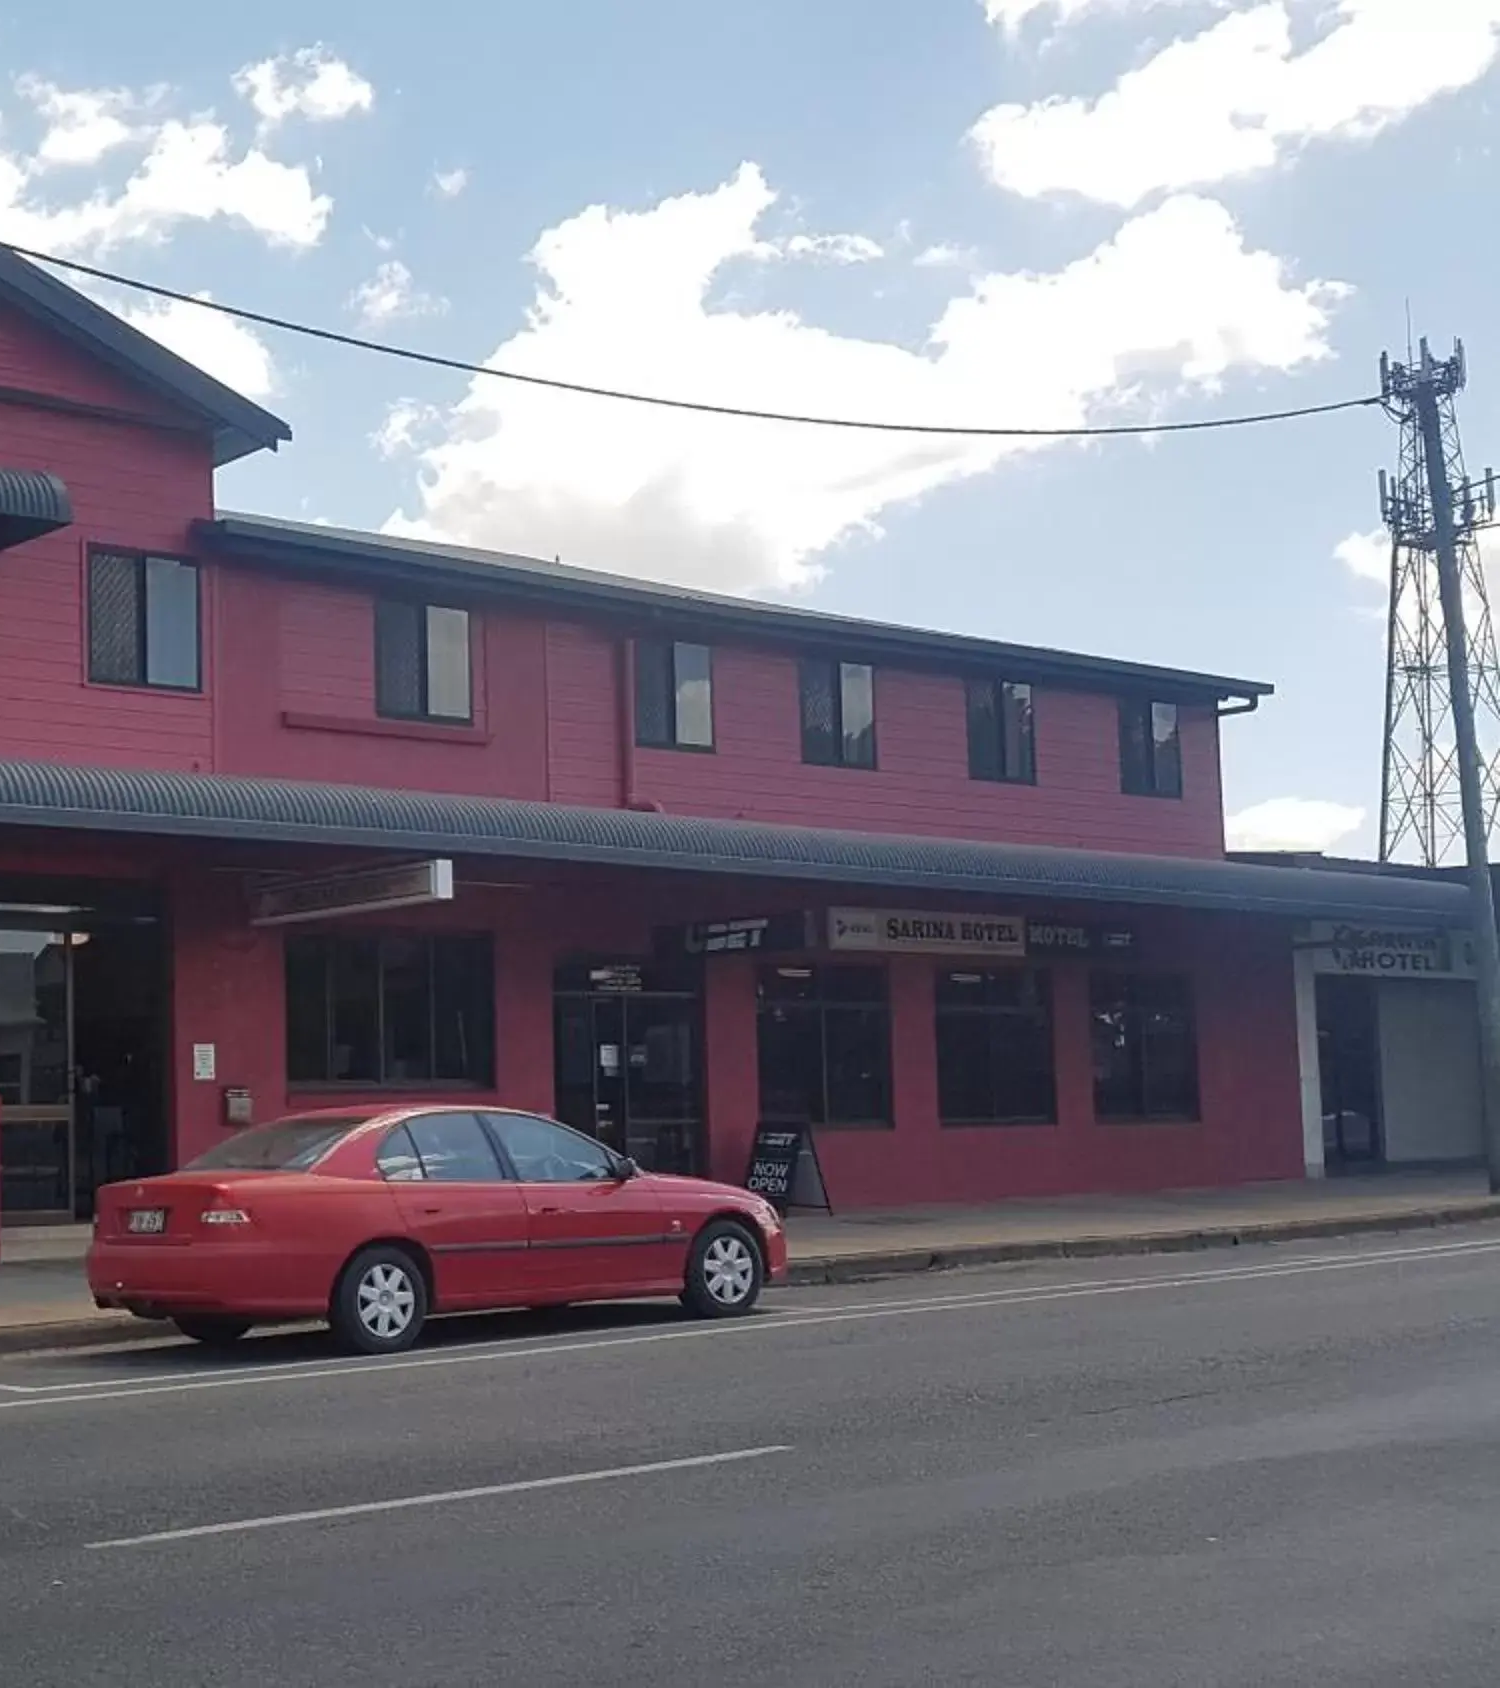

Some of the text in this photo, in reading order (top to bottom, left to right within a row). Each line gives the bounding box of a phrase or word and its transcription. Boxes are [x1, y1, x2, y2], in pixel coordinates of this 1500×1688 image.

[887, 917, 956, 940] SARINA
[960, 921, 1019, 942] HOTEL
[1359, 949, 1435, 972] HOTEL
[754, 1161, 789, 1178] NOW
[748, 1176, 788, 1193] OPEN
